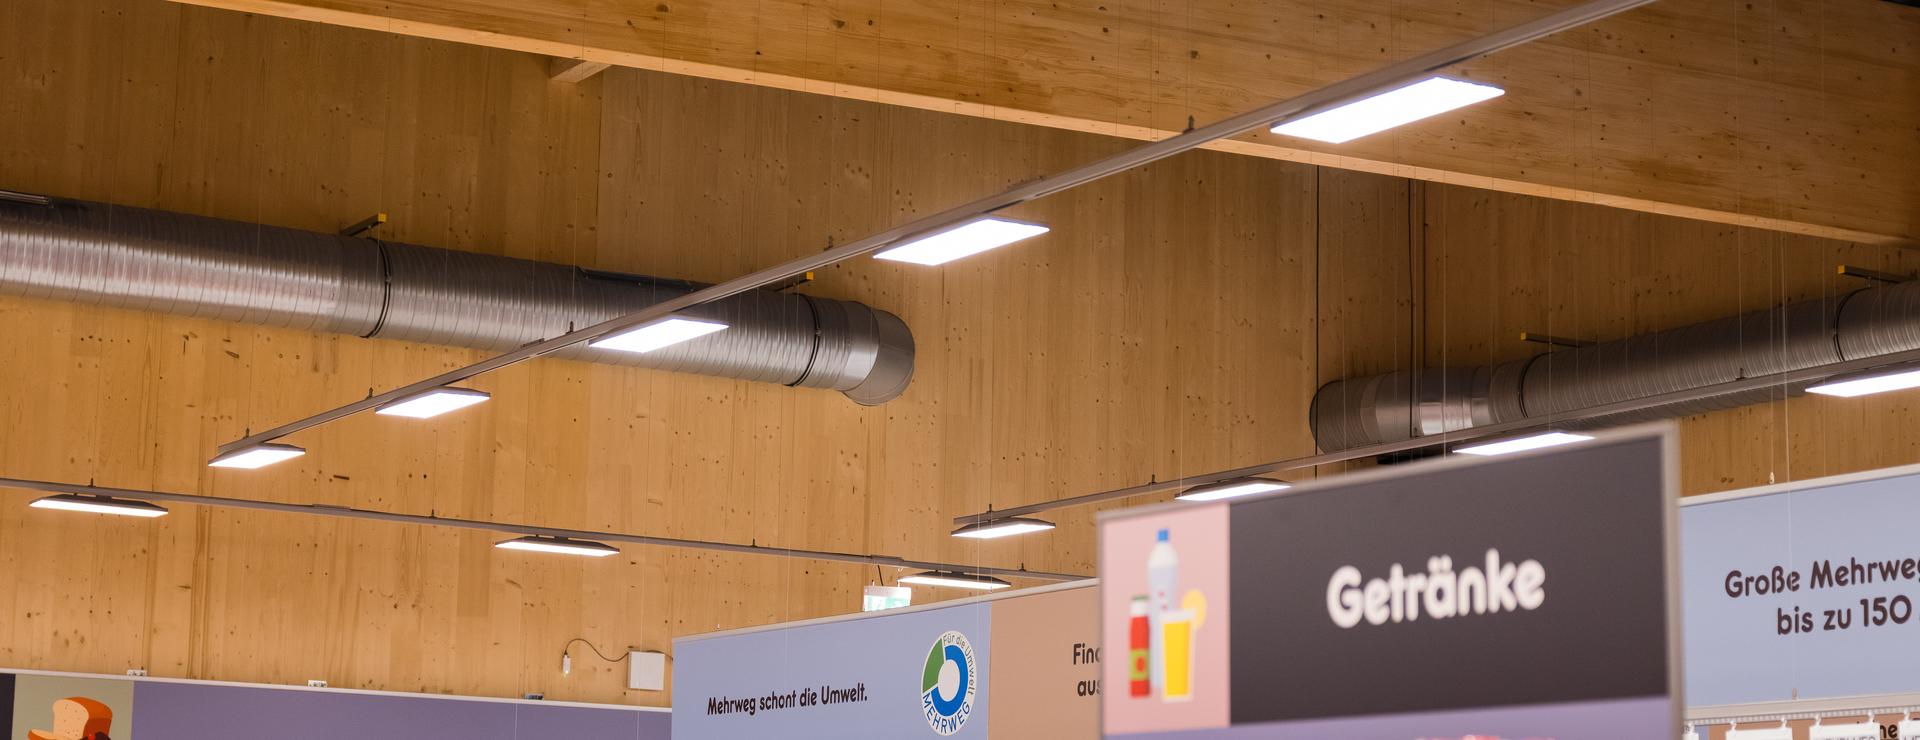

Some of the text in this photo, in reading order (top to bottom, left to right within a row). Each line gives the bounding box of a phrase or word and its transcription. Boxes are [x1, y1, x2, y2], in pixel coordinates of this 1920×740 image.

[1326, 547, 1546, 629] Getränke
[1725, 556, 1920, 598] Große Mehrwe
[1777, 594, 1912, 635] bis zu 150
[943, 633, 976, 695] Für die Umwelt
[707, 682, 868, 716] Mehrweg schont die Umwelt.
[923, 693, 970, 734] MEHRWEG
